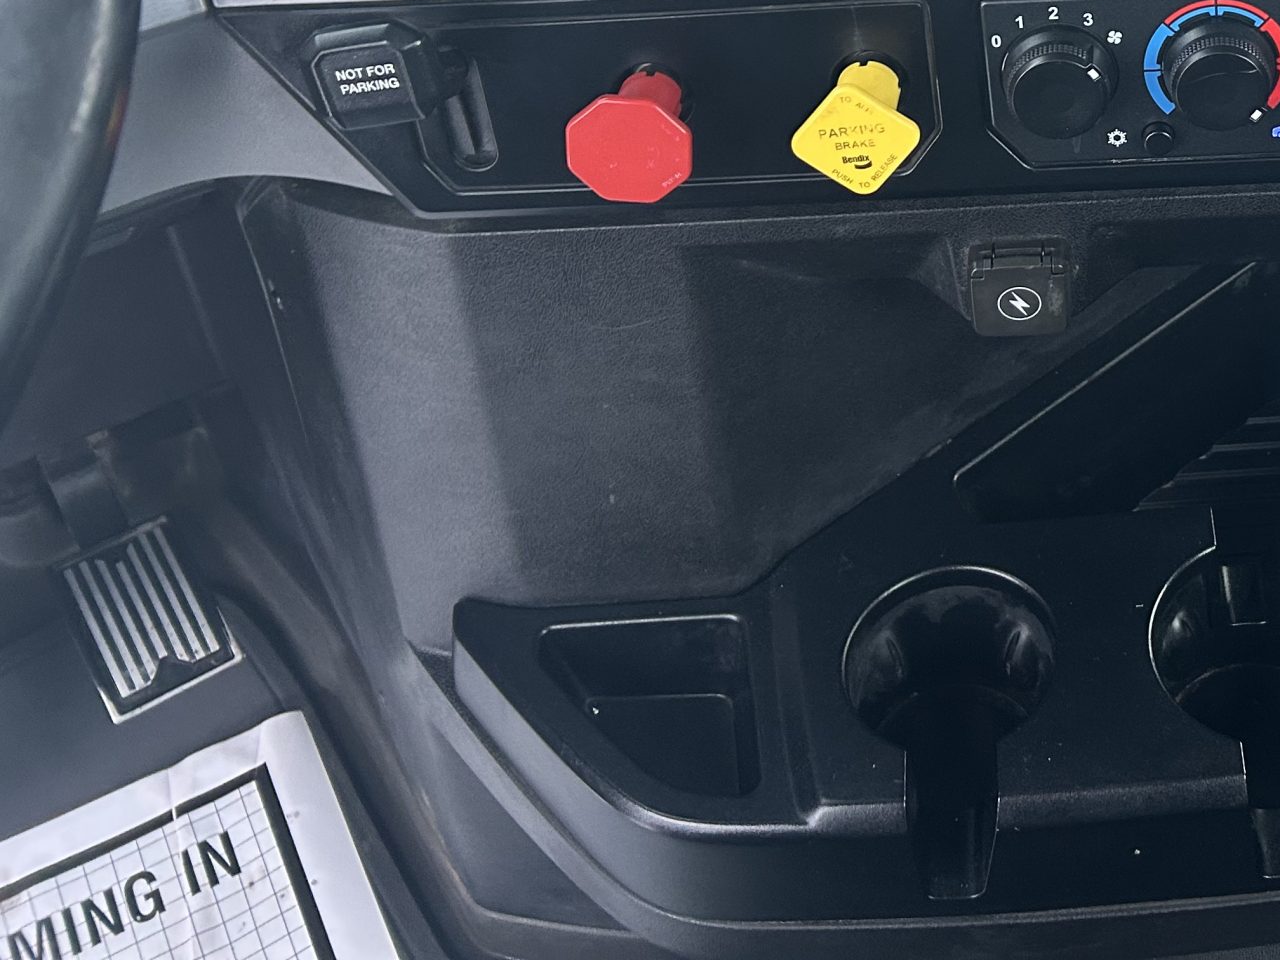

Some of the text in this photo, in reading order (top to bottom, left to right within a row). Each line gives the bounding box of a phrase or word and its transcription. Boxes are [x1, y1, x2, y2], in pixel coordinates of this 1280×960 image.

[1047, 7, 1059, 19] 2
[1083, 13, 1094, 26] 3
[1015, 16, 1024, 29] 1
[991, 35, 1001, 48] 0
[334, 63, 396, 81] NOT FOR
[340, 77, 400, 95] PARKING
[818, 123, 886, 140] PARKING
[835, 138, 876, 151] BRAKE
[842, 154, 870, 164] Bendix
[832, 153, 898, 189] PUSH TO RELEASE
[180, 830, 242, 897] IN
